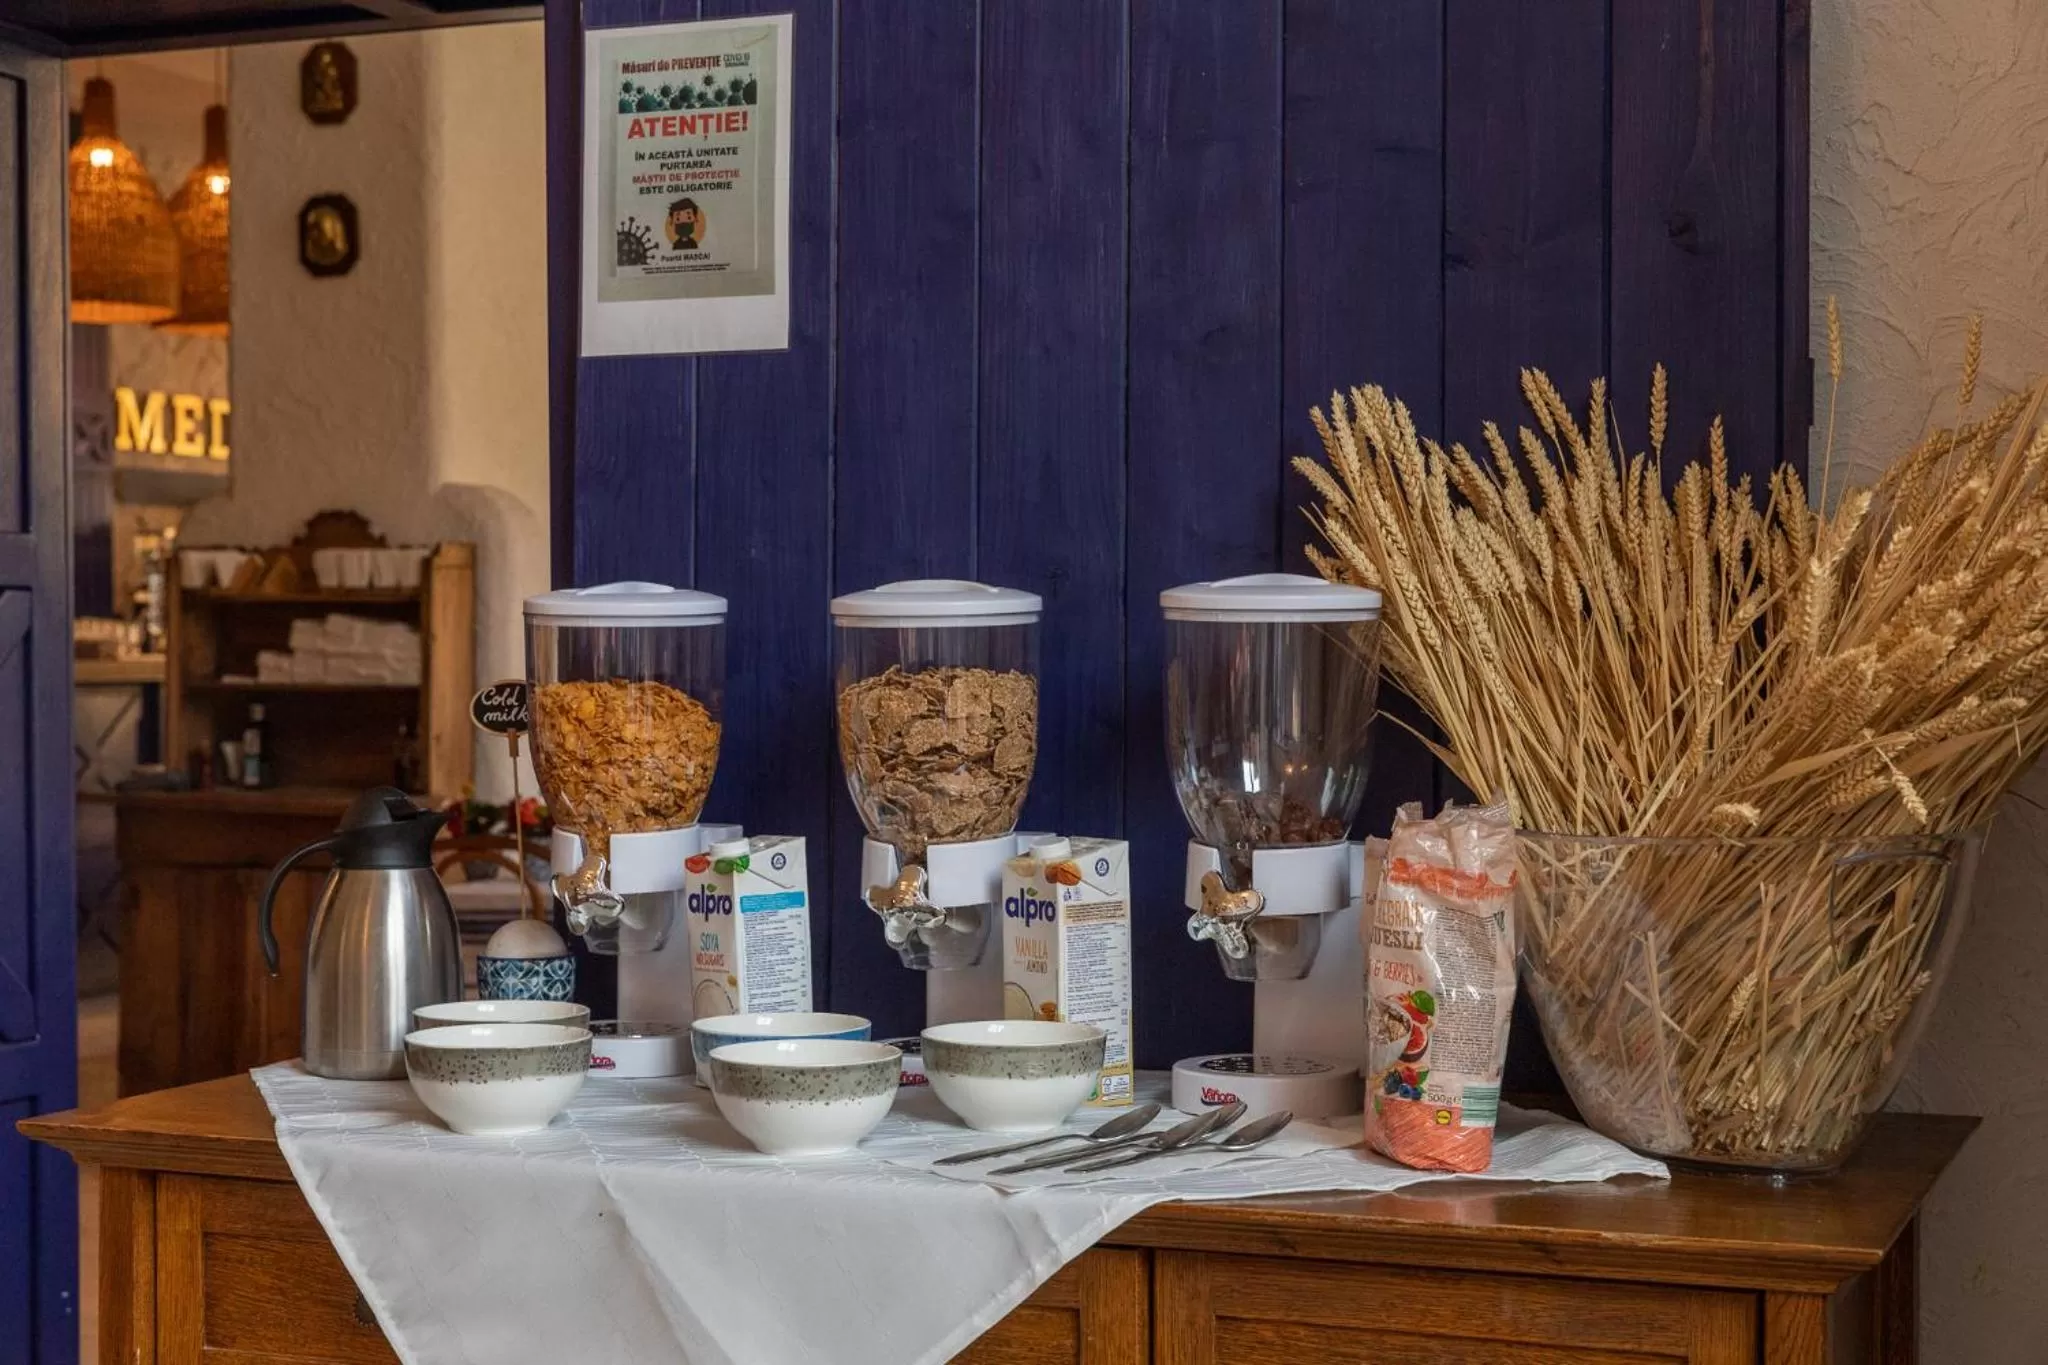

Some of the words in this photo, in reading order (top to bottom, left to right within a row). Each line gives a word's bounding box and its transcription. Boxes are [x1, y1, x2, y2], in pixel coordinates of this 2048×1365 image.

[696, 147, 738, 157] UNITATE
[660, 160, 712, 170] PURTAREA
[669, 173, 682, 182] DE
[639, 186, 664, 195] ESTE
[667, 181, 733, 193] OBLIGATORIE
[481, 686, 520, 706] Cold
[483, 704, 530, 723] milk
[688, 884, 732, 922] alpro
[1005, 888, 1056, 927] alpro
